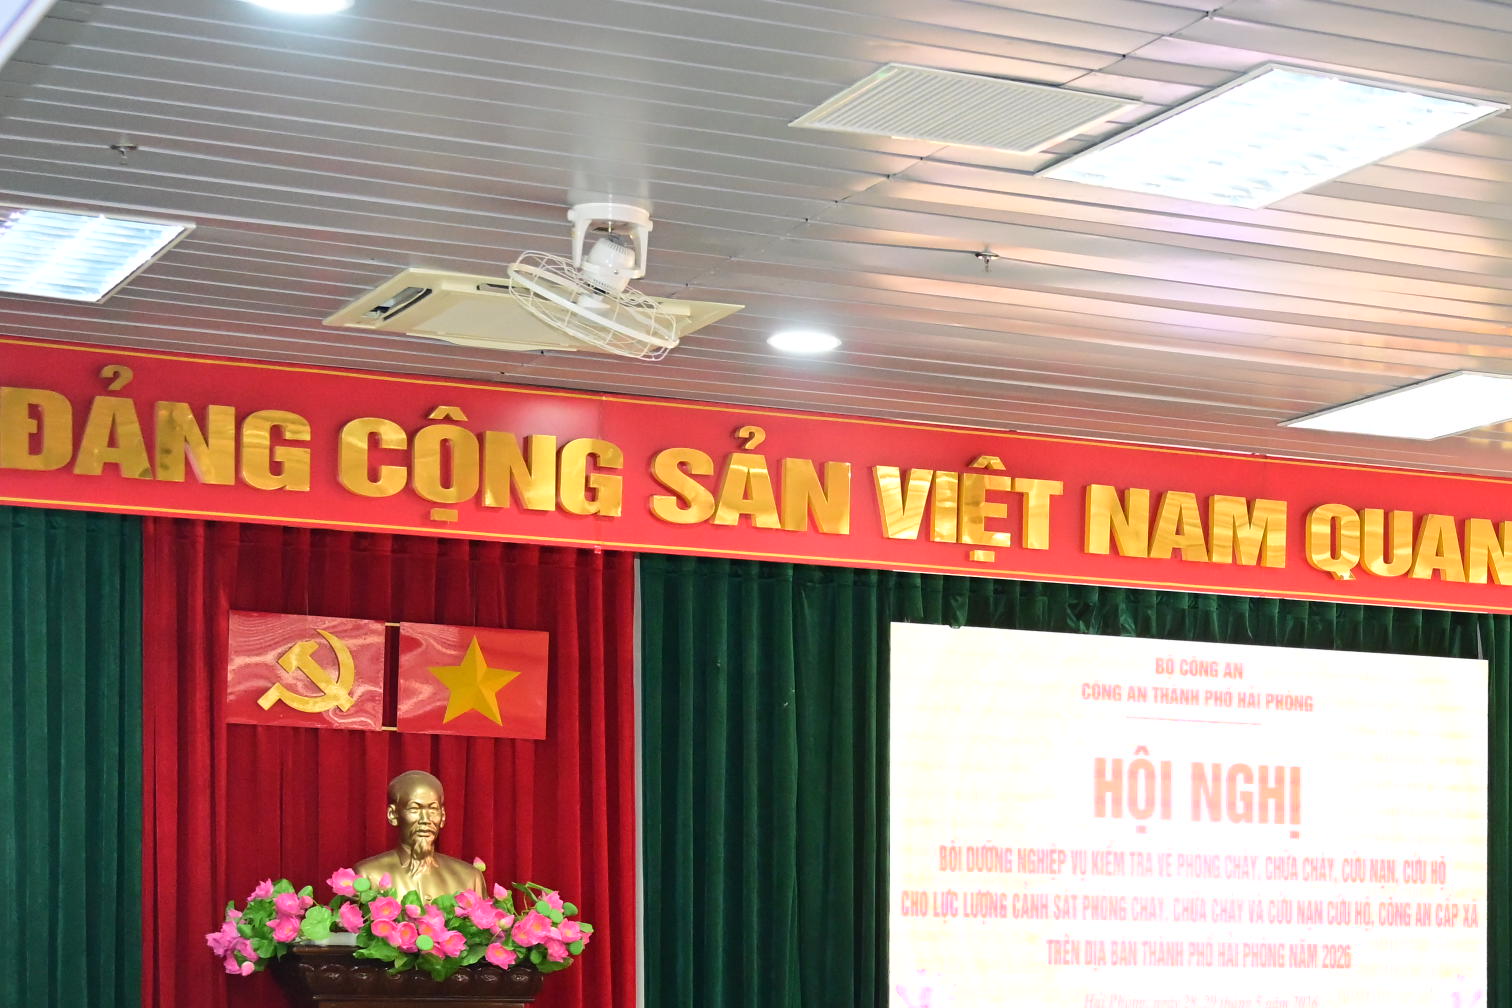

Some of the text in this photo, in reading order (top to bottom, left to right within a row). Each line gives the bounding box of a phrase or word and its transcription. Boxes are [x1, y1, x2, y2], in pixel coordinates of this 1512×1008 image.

[0, 364, 311, 492] ĐẢNG
[337, 405, 625, 524] CỘNG
[648, 425, 851, 535] SẢN
[872, 455, 1064, 563] VIỆT
[1083, 484, 1288, 569] NAM
[1179, 656, 1219, 678] CÔNG
[1223, 662, 1244, 680] AN
[1081, 680, 1122, 702] CÔNG
[1126, 685, 1147, 703] AN
[1093, 745, 1302, 839] HỘI NGHỊ
[1129, 851, 1153, 878] TRA
[900, 890, 929, 918] CHO
[1415, 903, 1432, 927] AN
[1046, 933, 1081, 966] TRÊN
[1321, 944, 1352, 970] 2026
